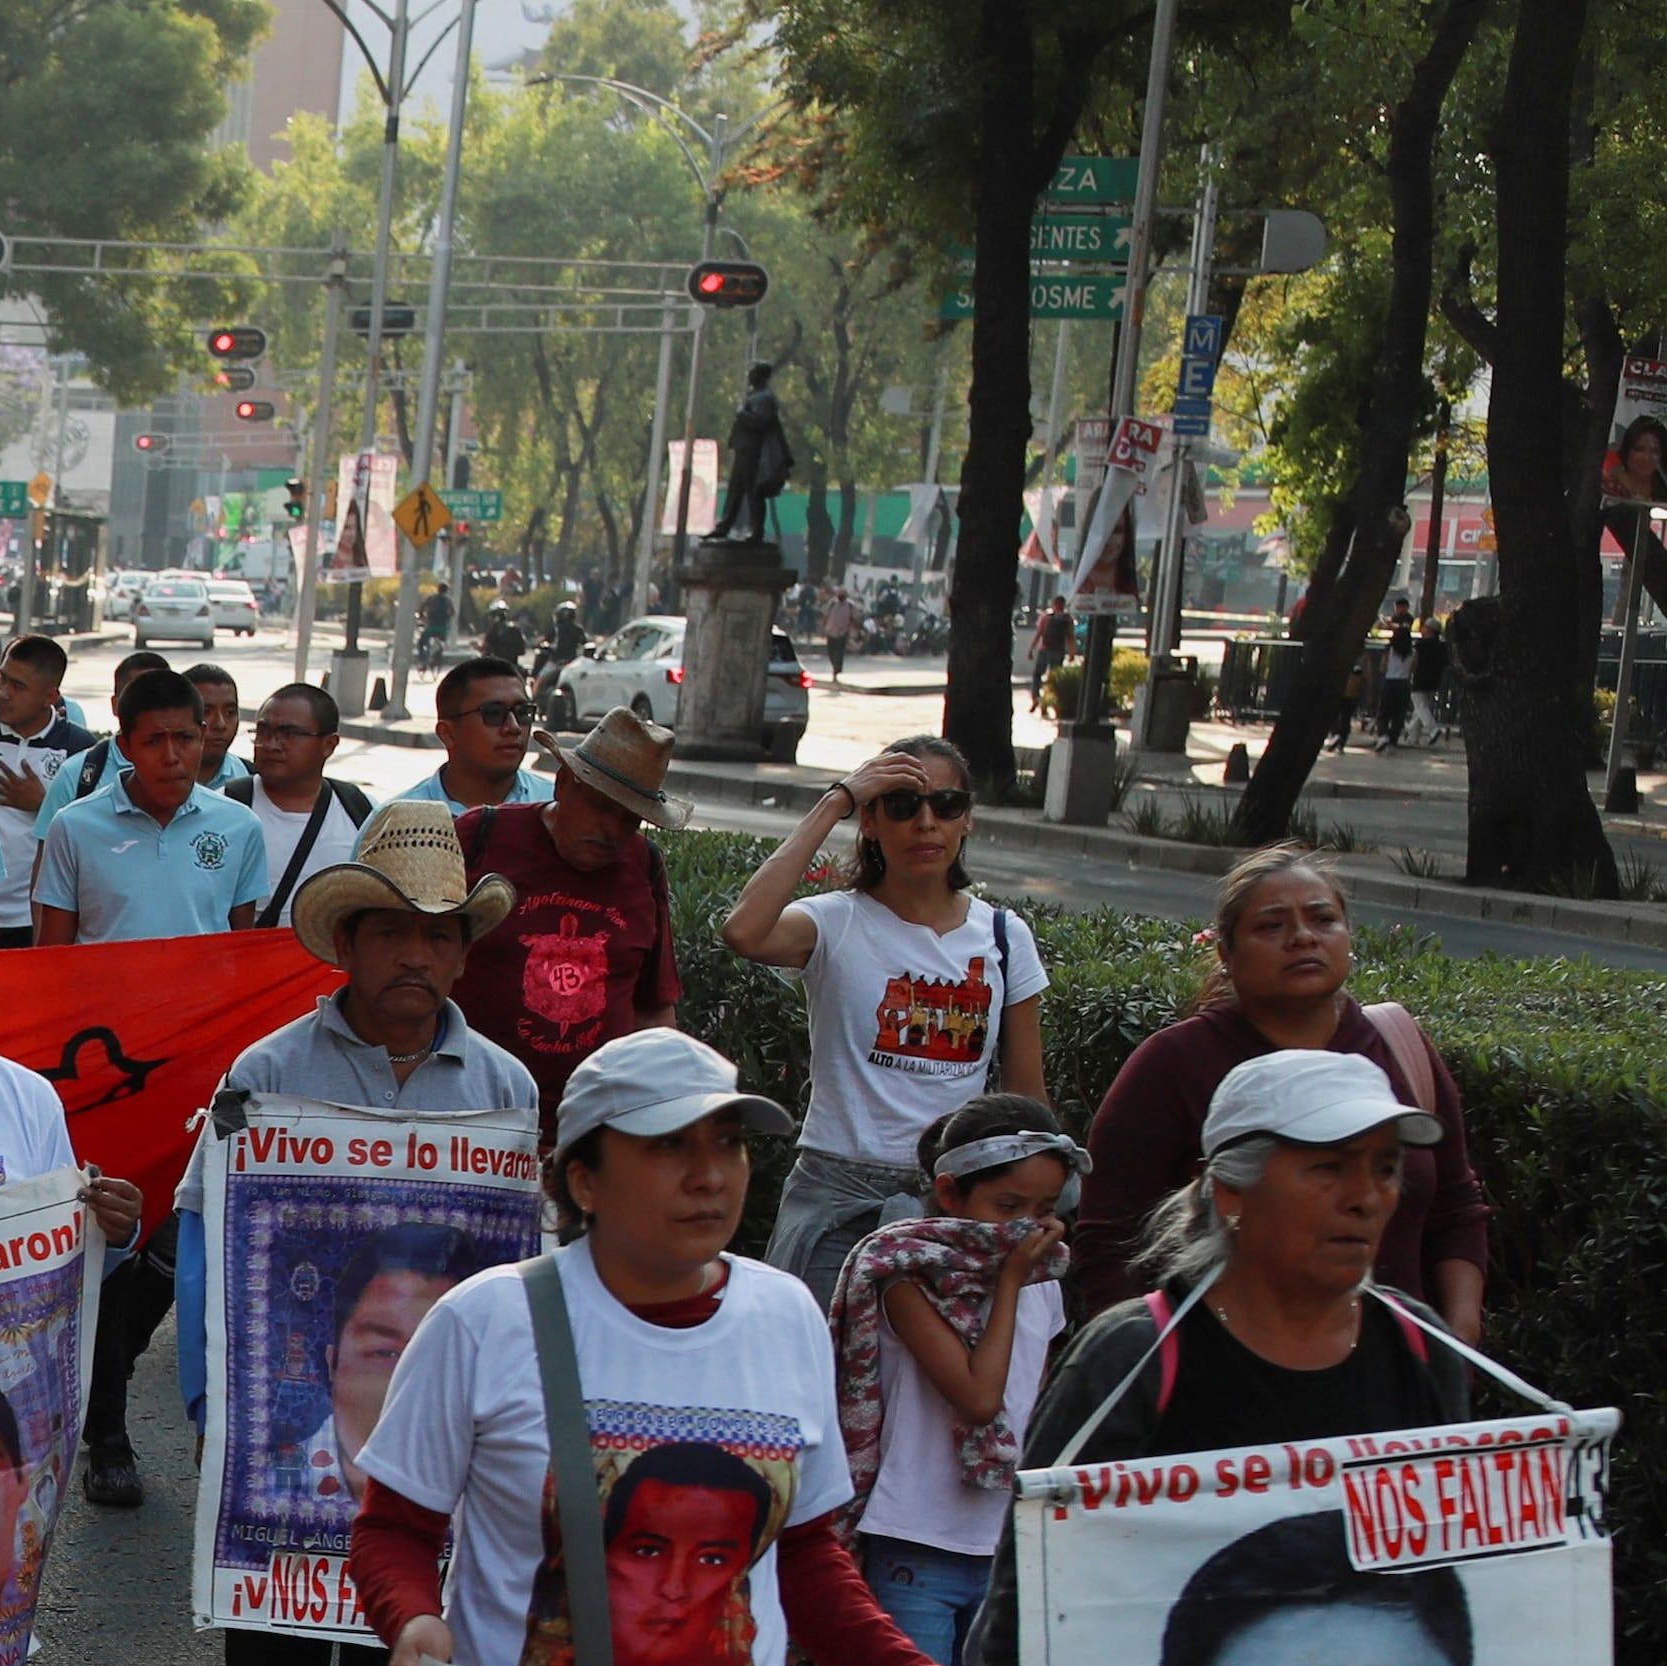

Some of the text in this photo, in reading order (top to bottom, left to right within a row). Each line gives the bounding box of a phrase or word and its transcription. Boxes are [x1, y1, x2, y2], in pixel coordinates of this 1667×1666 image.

[1030, 285, 1096, 309] OSME
[1184, 361, 1209, 393] E
[553, 966, 580, 992] 43
[867, 1051, 915, 1072] ALTO A LA
[235, 1127, 438, 1172] ¡Vivo se lo
[1213, 1444, 1337, 1499] se lo
[1343, 1439, 1568, 1566] NOS FALTAN
[271, 1555, 330, 1624] NOS
